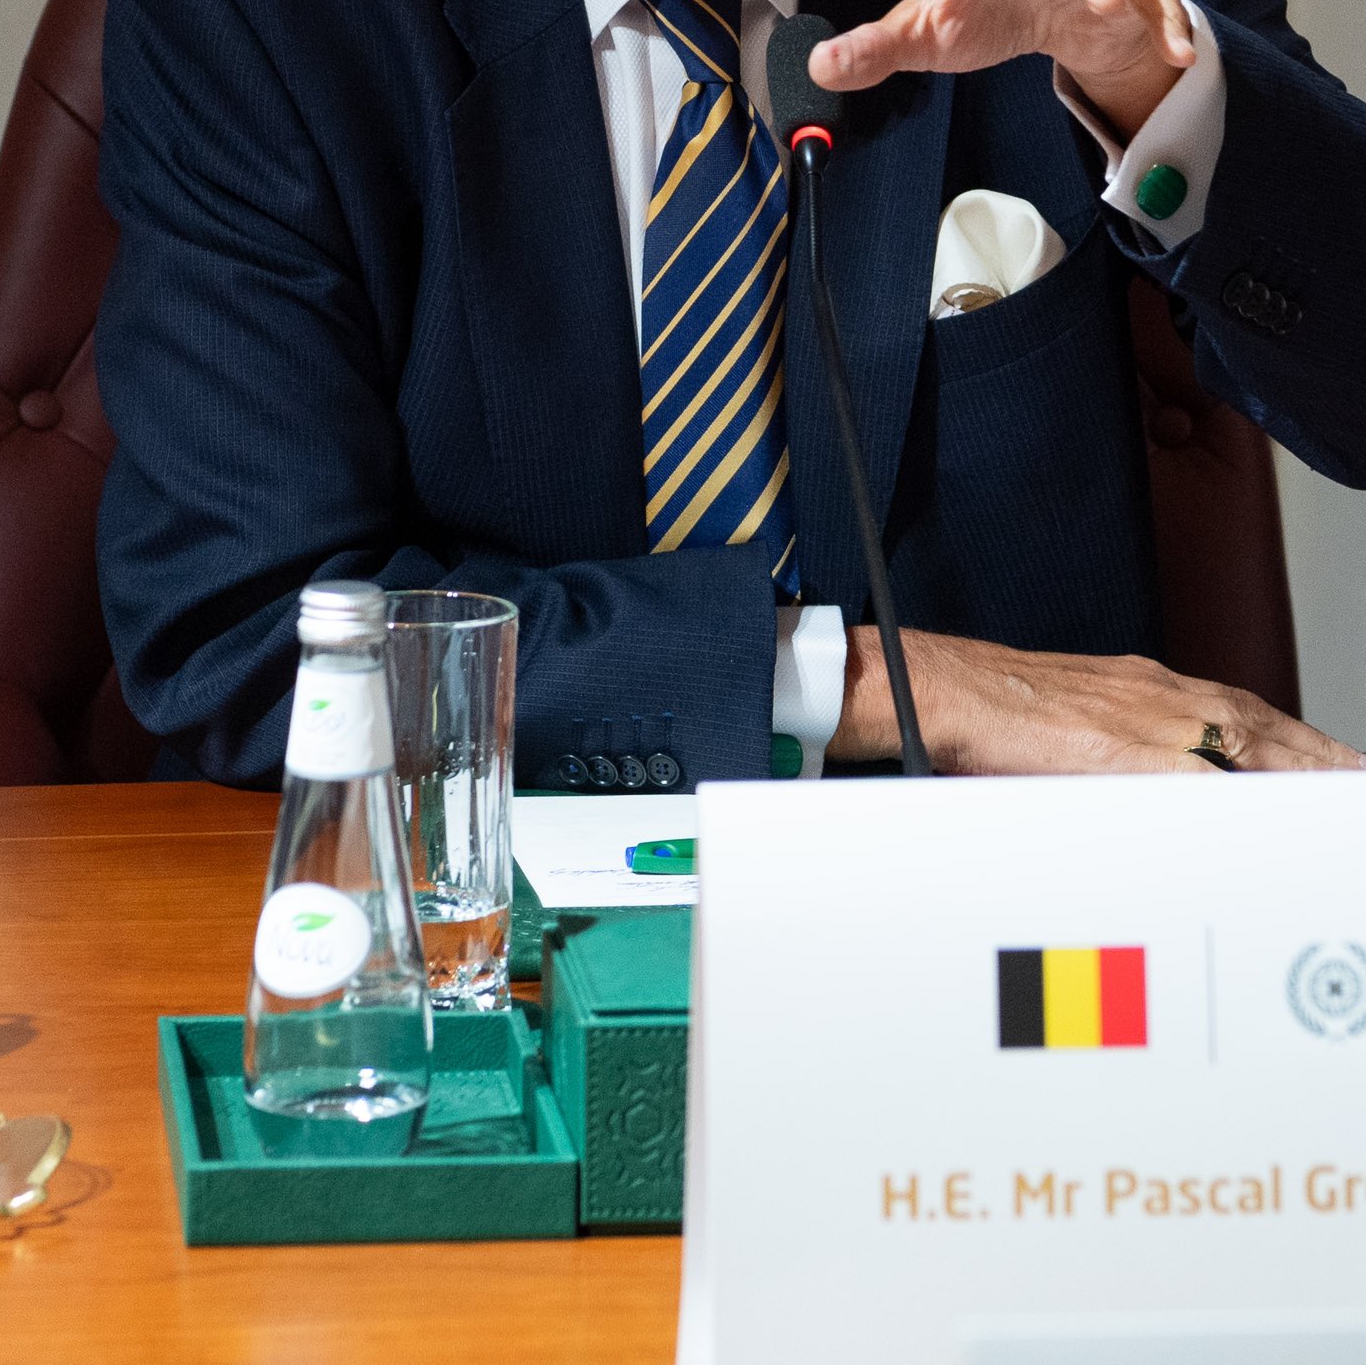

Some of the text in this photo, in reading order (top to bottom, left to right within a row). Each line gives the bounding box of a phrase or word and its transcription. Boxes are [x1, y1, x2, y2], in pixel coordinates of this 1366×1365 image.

[881, 1171, 990, 1220] H.E.
[1011, 1170, 1082, 1219] Mr
[1104, 1164, 1283, 1217] Pascal
